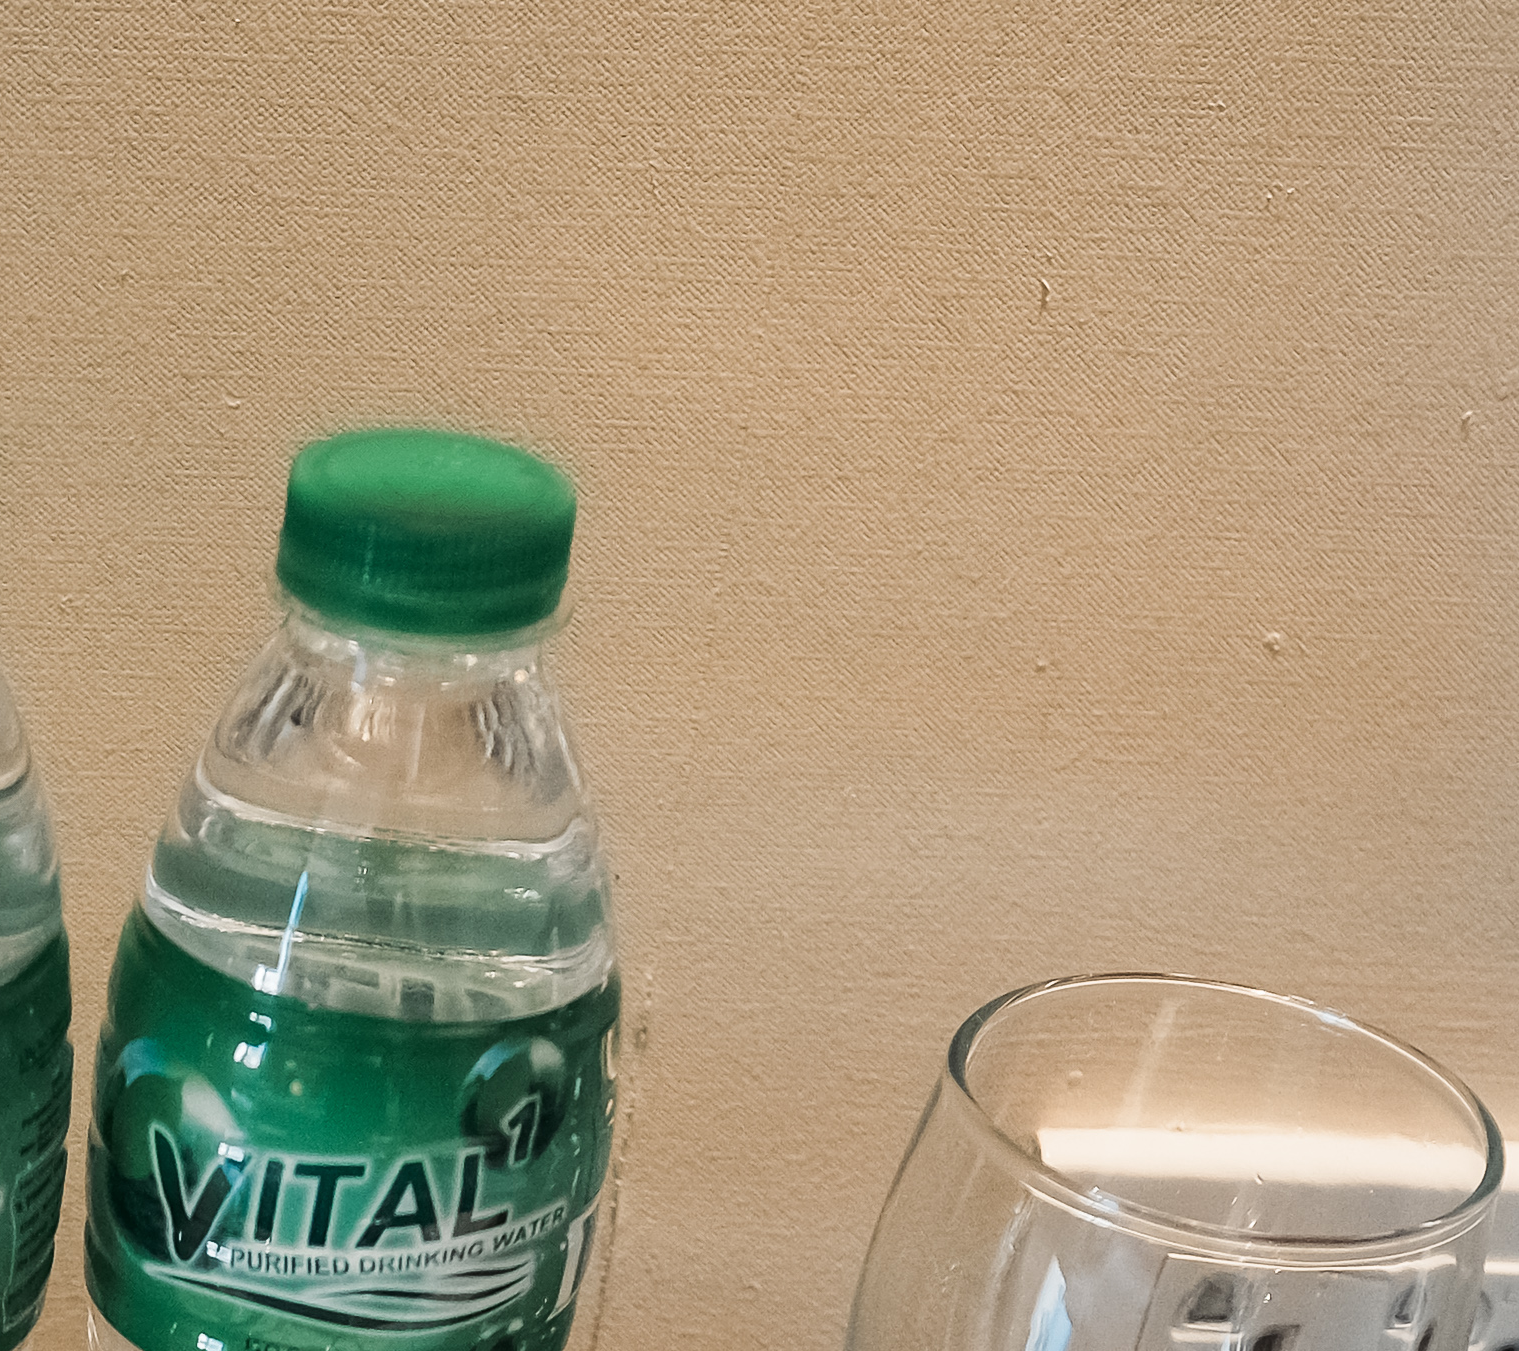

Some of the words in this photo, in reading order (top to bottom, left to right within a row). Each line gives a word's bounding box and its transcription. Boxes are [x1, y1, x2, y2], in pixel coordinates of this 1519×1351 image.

[151, 1124, 511, 1263] VITAL
[229, 1248, 350, 1277] PURIFIED
[360, 1241, 484, 1275] DRINKING
[493, 1205, 566, 1253] WATER
